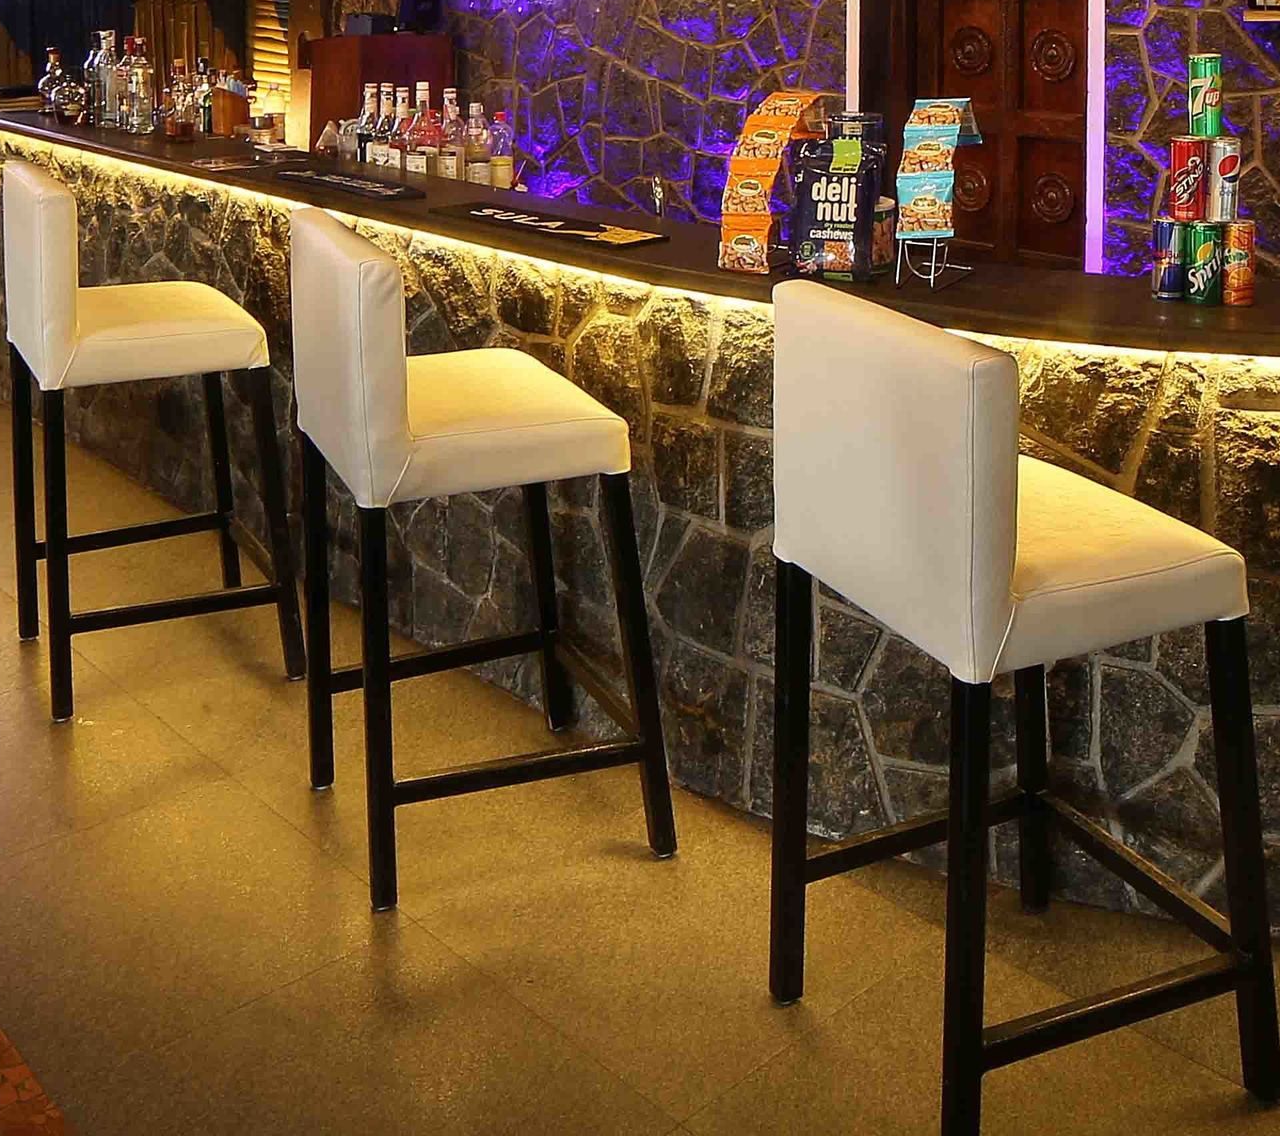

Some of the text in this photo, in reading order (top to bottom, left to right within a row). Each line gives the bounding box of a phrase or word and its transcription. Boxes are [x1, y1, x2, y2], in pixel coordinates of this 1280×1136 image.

[811, 176, 857, 203] déli
[470, 208, 565, 229] SULA
[817, 201, 857, 222] nut
[810, 228, 854, 240] cashews
[1187, 243, 1222, 294] Sprit
